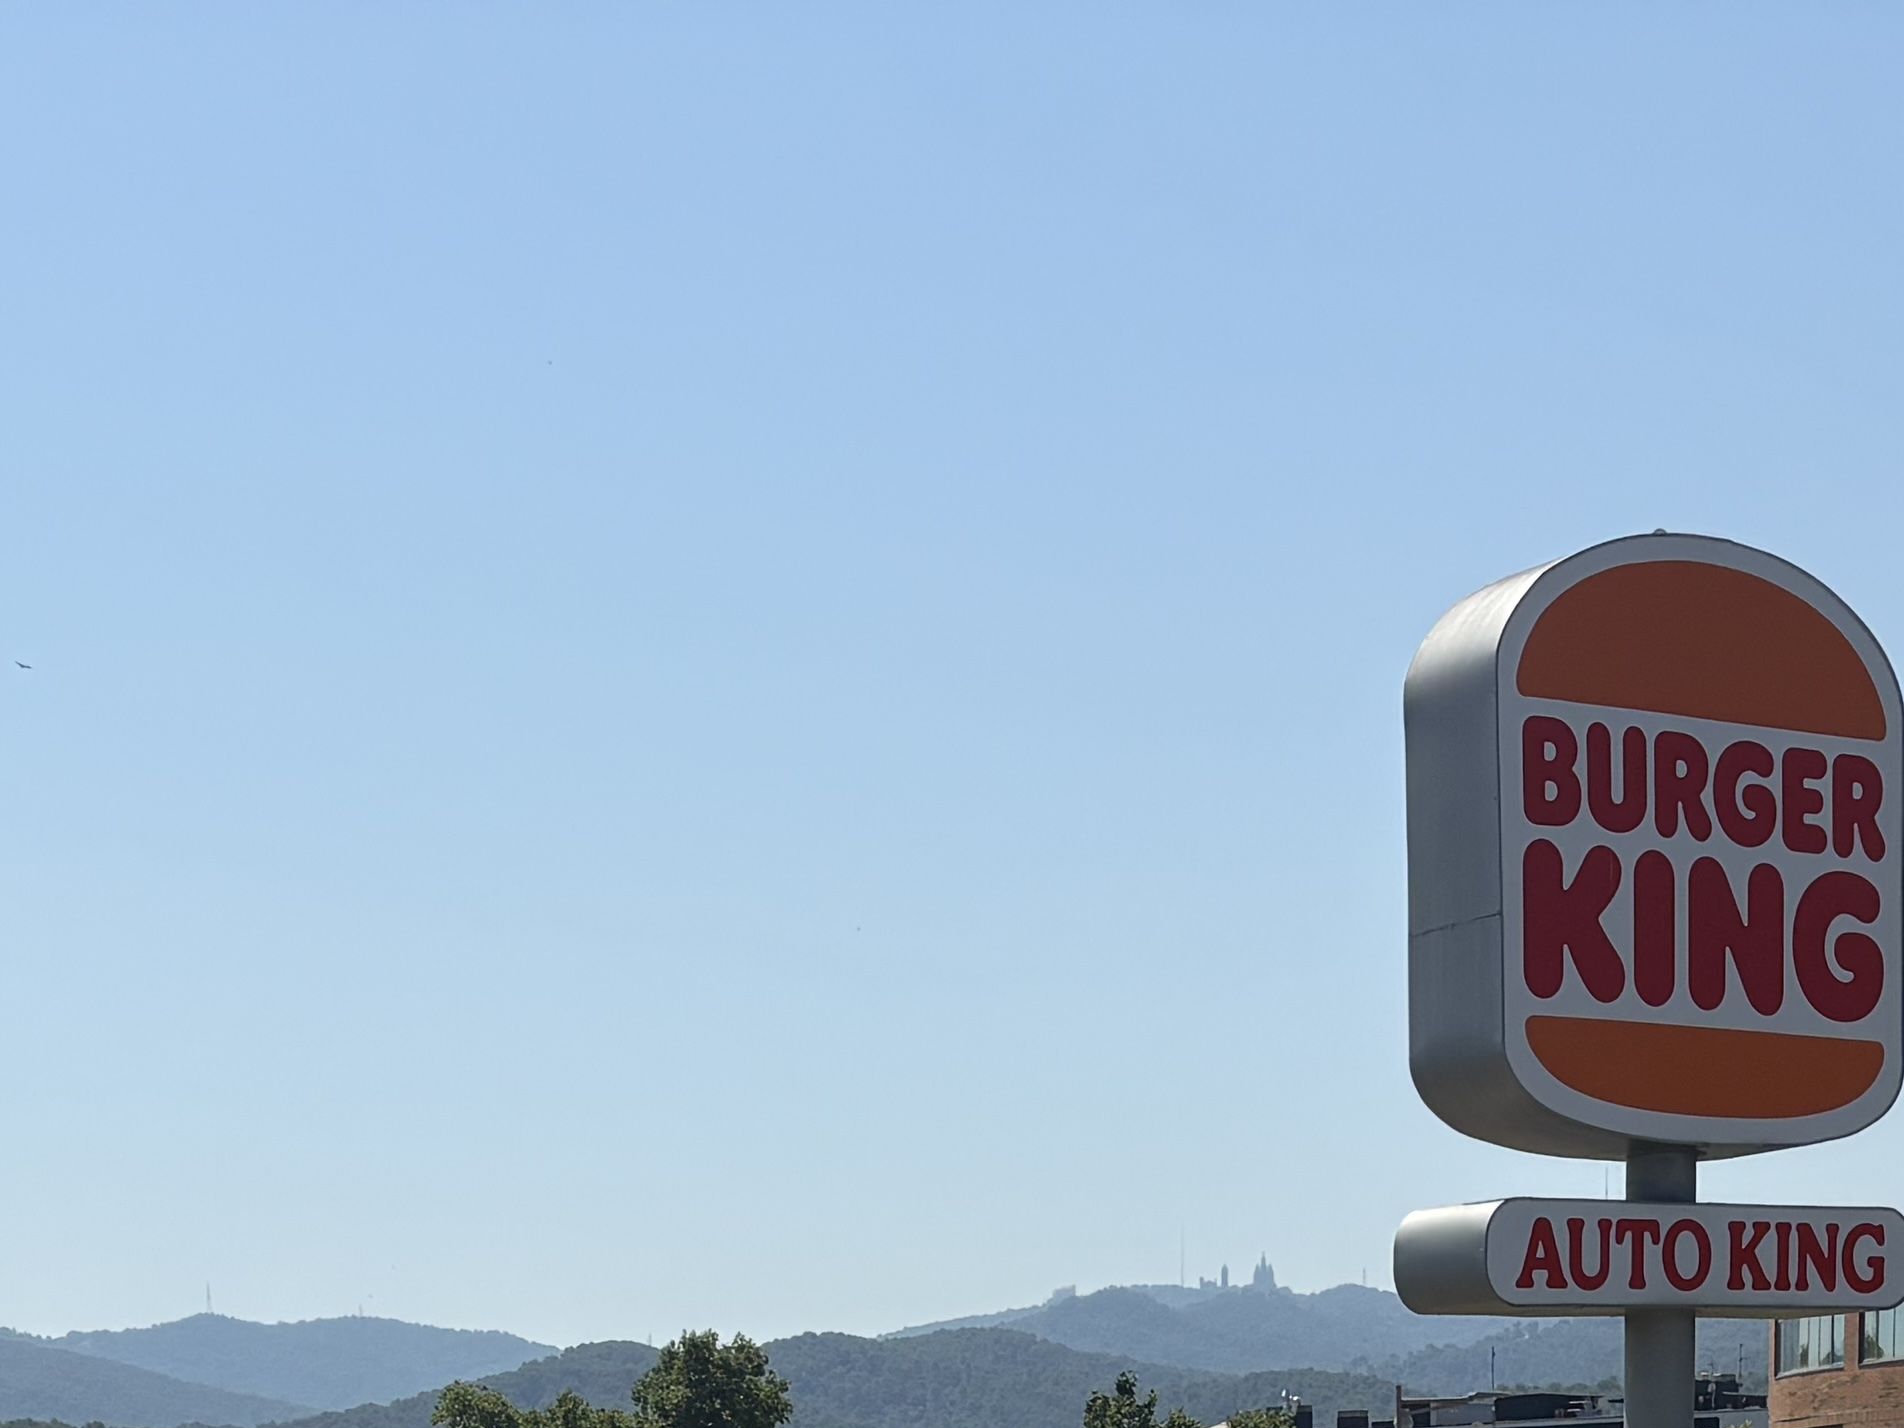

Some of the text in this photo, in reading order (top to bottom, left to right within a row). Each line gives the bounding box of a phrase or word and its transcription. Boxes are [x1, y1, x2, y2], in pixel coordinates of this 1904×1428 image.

[1522, 715, 1886, 863] BURGER
[1522, 838, 1885, 1023] KING
[1515, 1217, 1885, 1294] AUTO KING
